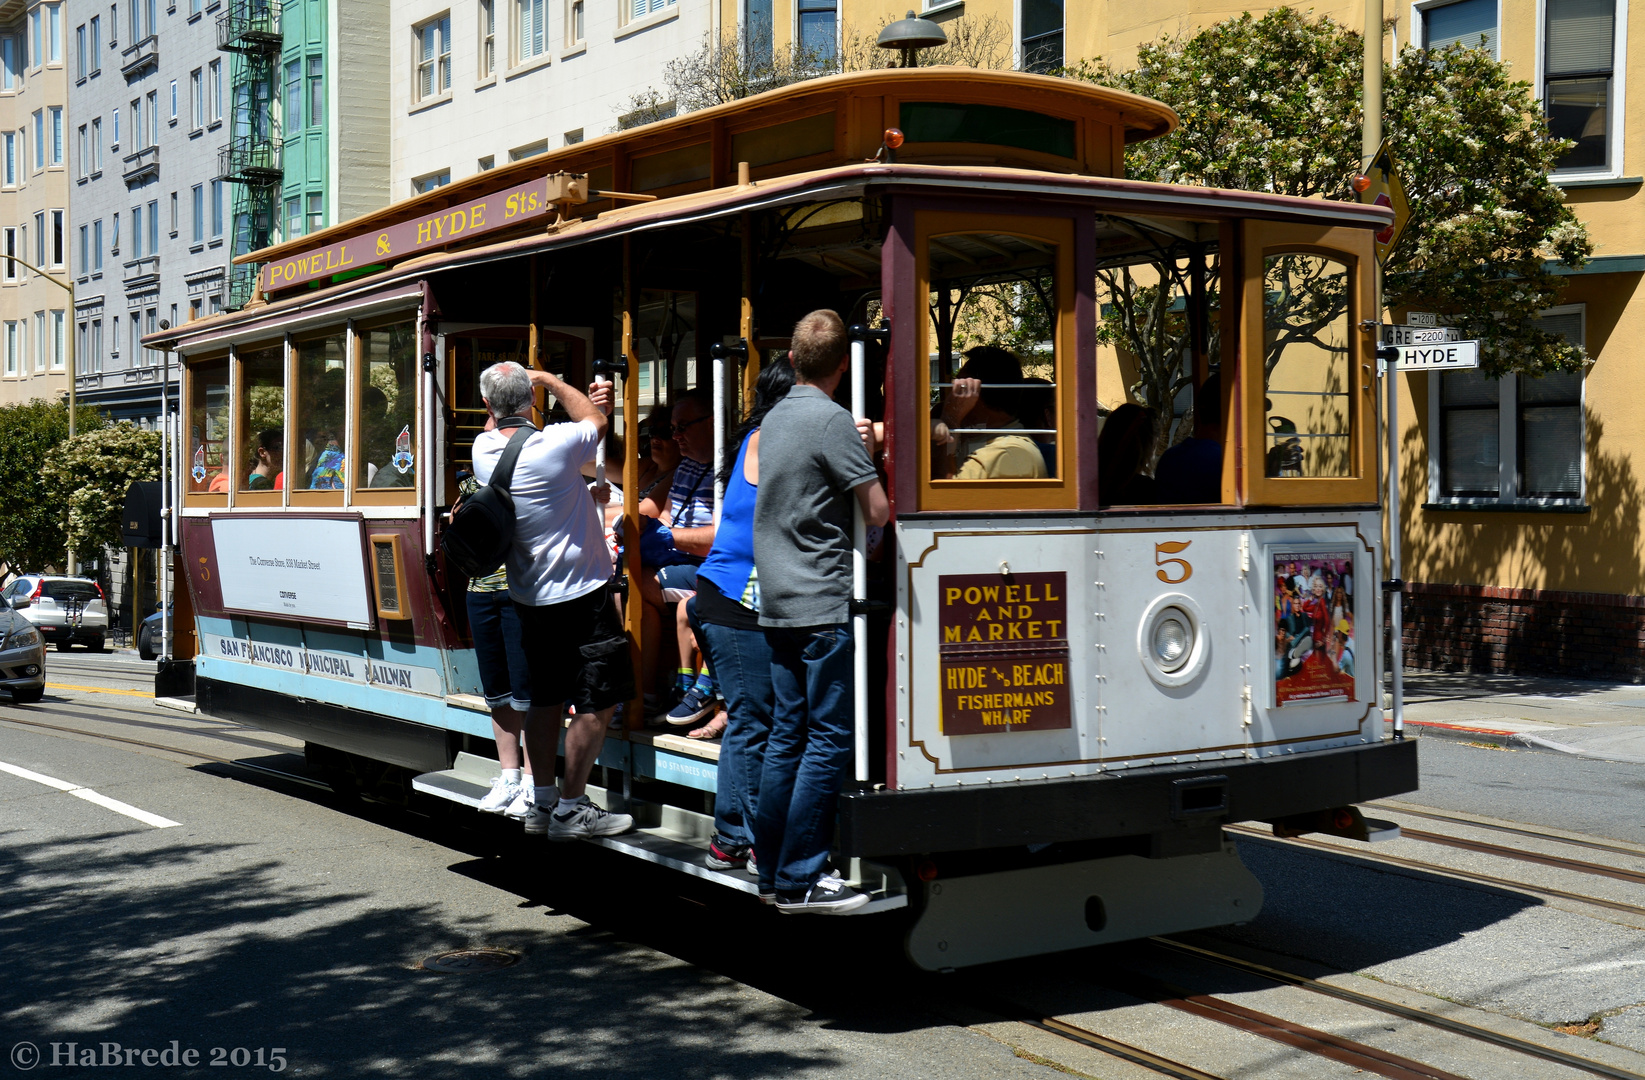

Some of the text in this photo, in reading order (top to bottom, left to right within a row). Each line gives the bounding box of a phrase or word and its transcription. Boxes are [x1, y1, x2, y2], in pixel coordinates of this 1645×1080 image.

[270, 190, 543, 286] POWELL & HYDE Sts.
[1418, 314, 1434, 325] 1200
[1421, 331, 1444, 342] 2200
[1405, 348, 1458, 364] HYDE
[199, 556, 210, 581] 5
[1155, 540, 1192, 584] 5
[946, 583, 1059, 606] POWELL
[976, 605, 1033, 622] AND
[944, 620, 1062, 643] MARKET
[220, 639, 239, 656] SAN
[947, 663, 1064, 690] HYDE AND BEACH
[958, 691, 1055, 711] FISHERMANS
[982, 709, 1032, 726] WHARF
[669, 762, 700, 776] STANDEES
